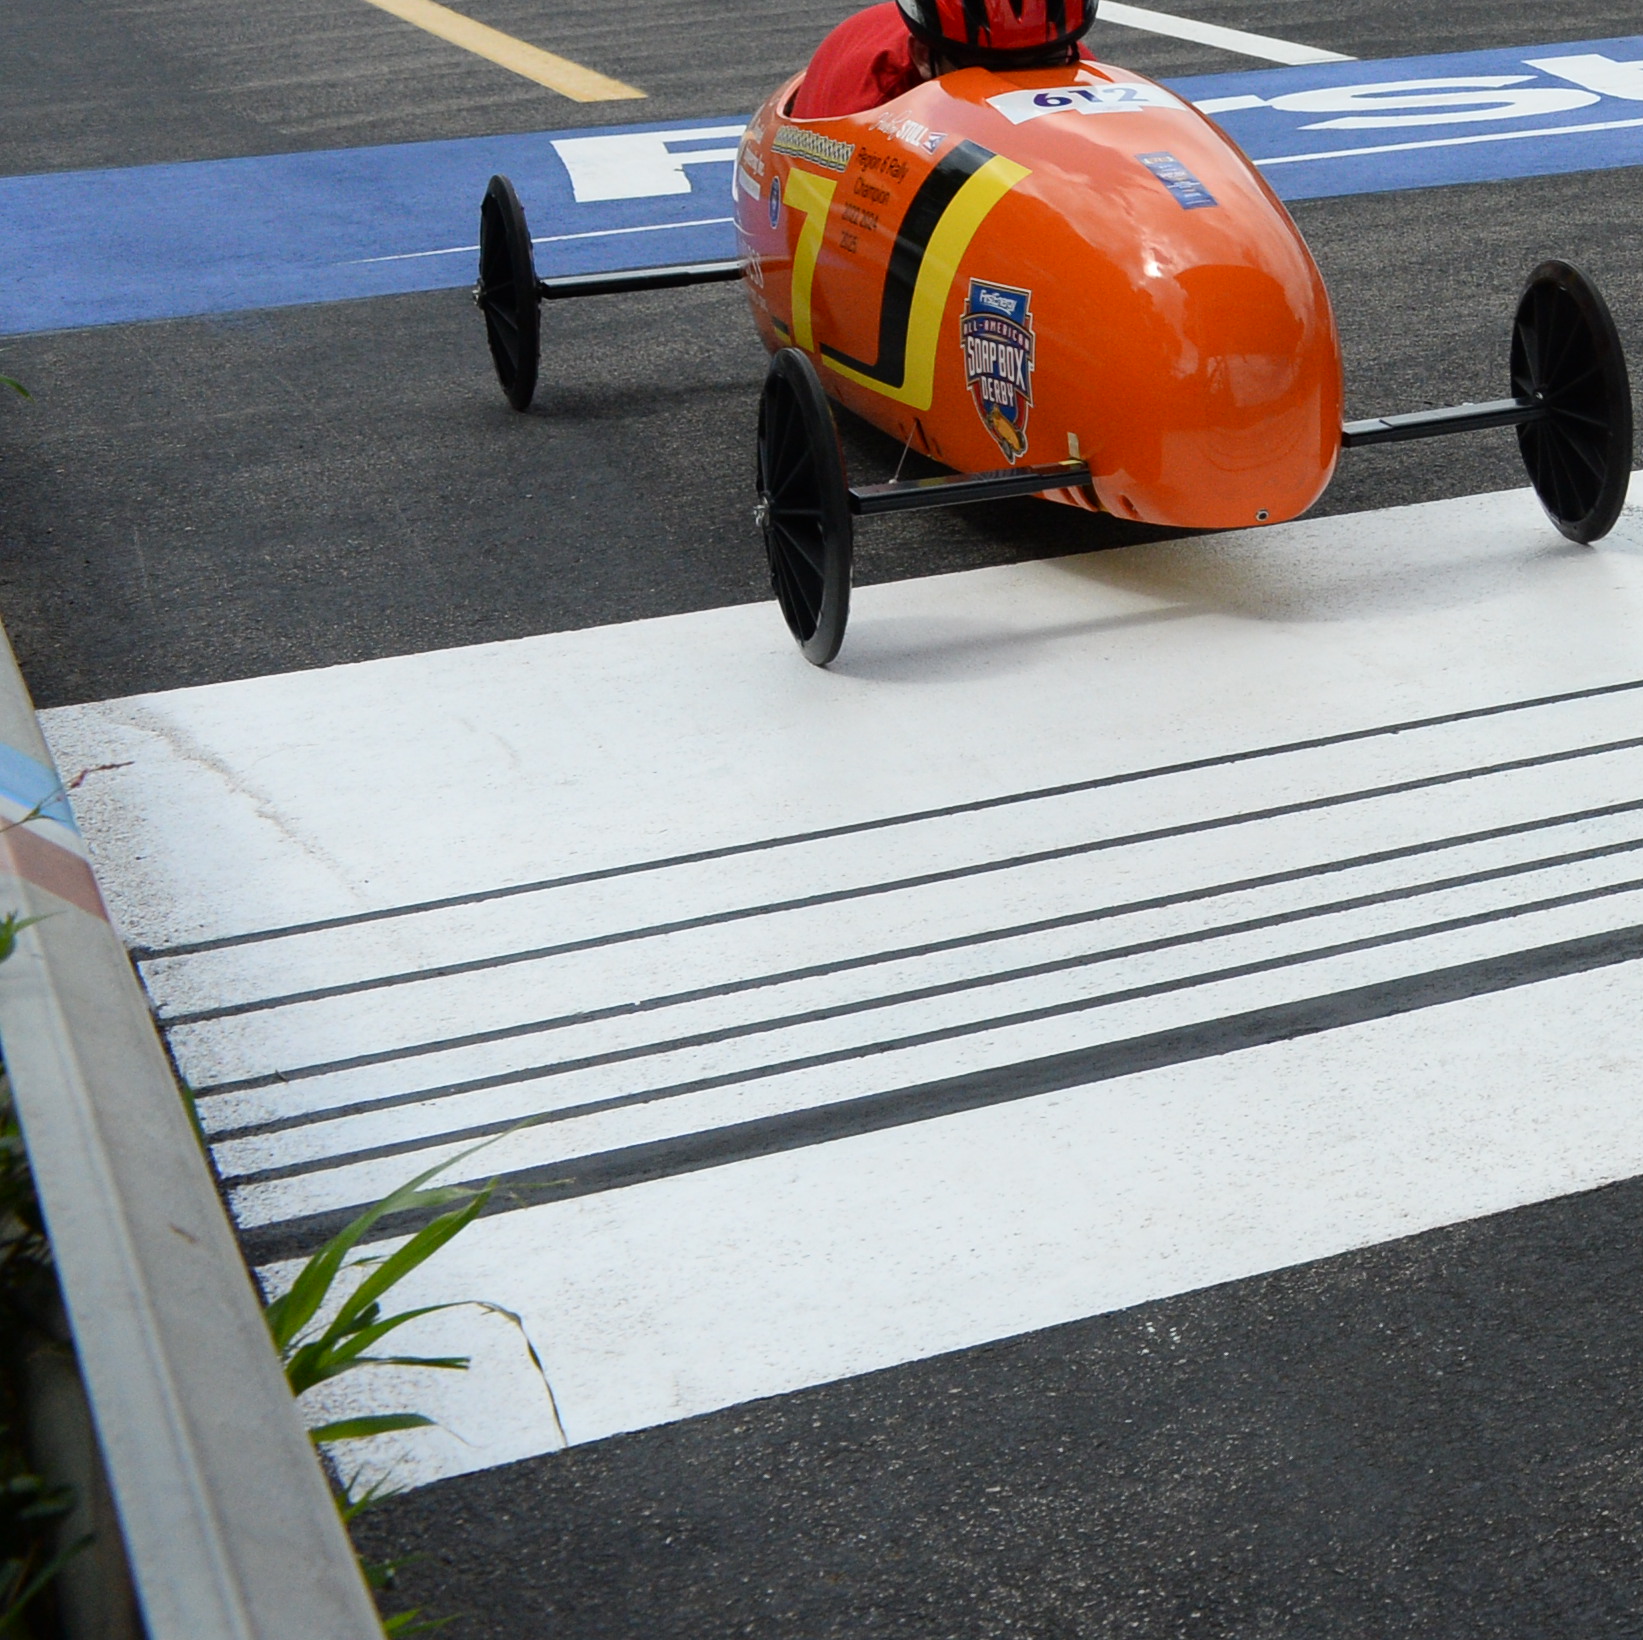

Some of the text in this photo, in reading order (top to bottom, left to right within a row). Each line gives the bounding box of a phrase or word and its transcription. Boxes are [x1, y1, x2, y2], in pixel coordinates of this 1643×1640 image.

[1033, 87, 1150, 108] 612
[856, 146, 882, 173] Region
[853, 176, 891, 205] Champion
[979, 289, 1018, 313] FirstEnergy
[963, 319, 1030, 351] ALL-AMERICAN
[967, 336, 1026, 391] SOAP BOX
[981, 376, 1014, 408] DERBY
